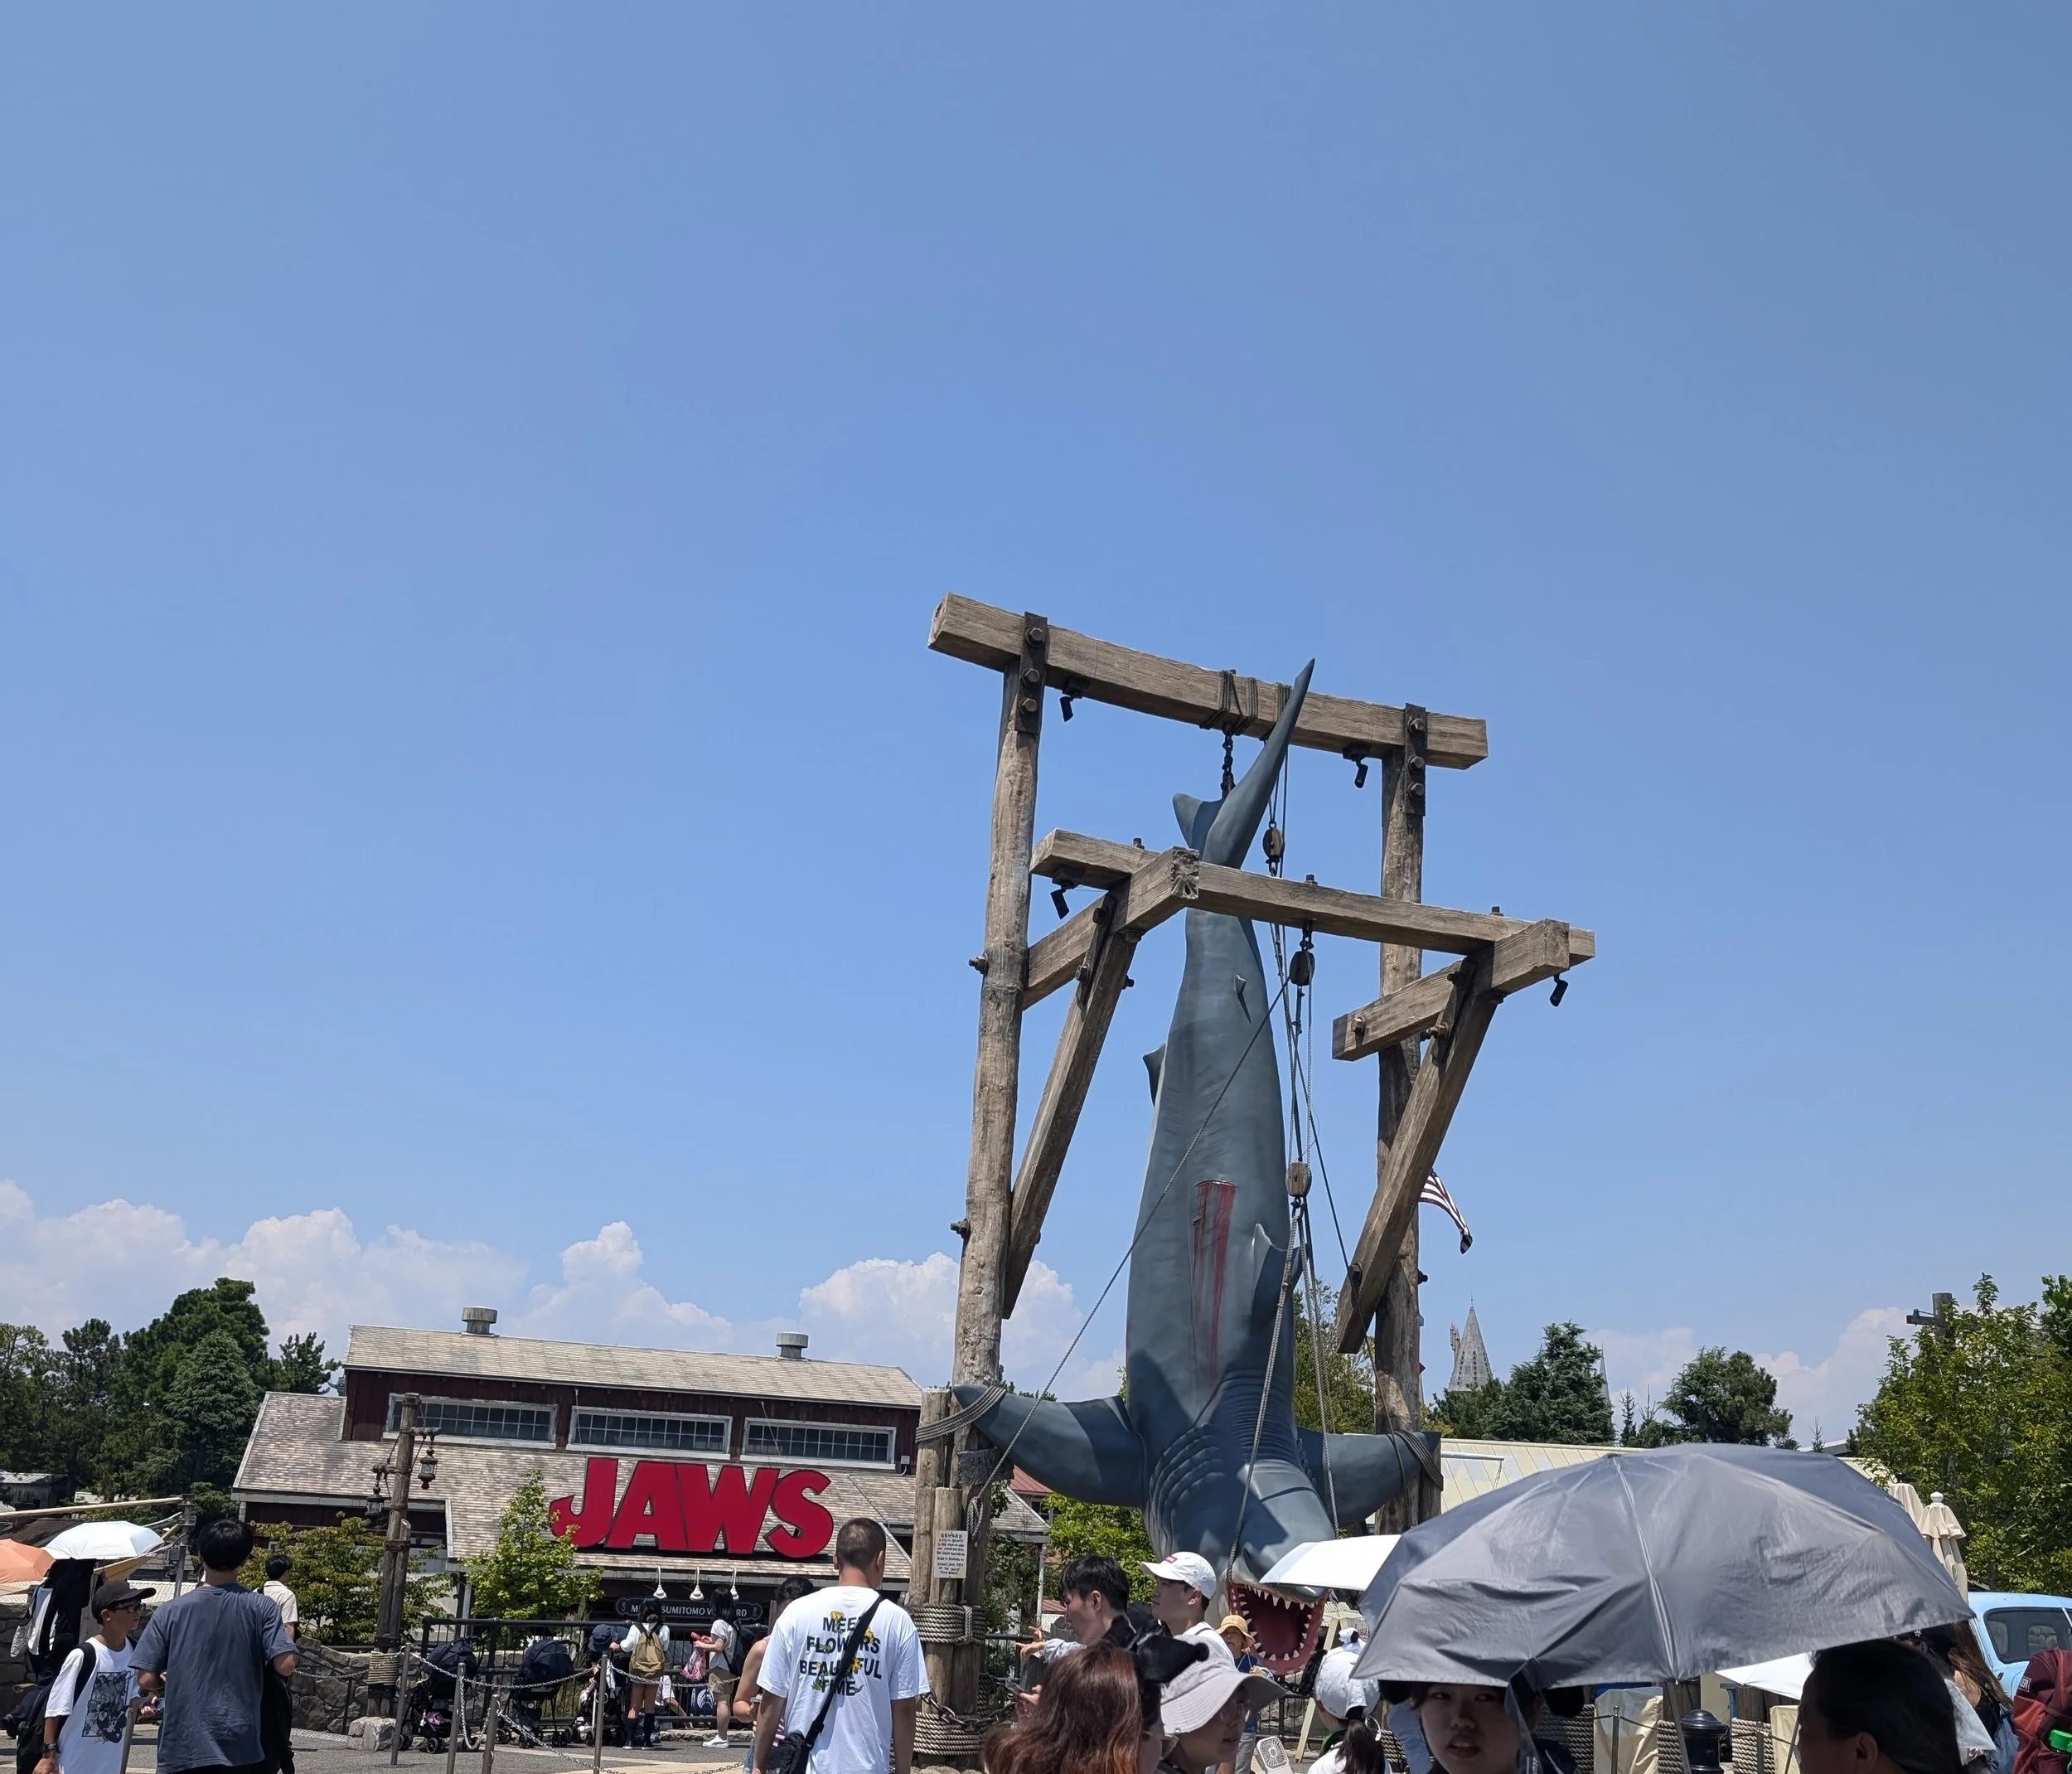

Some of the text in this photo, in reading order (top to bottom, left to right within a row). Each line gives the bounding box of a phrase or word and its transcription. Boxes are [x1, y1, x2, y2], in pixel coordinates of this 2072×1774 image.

[549, 1457, 834, 1558] JAWS
[661, 1606, 705, 1616] SUMITOMO
[822, 1616, 863, 1633] MEE
[806, 1636, 880, 1654] FLOWRS
